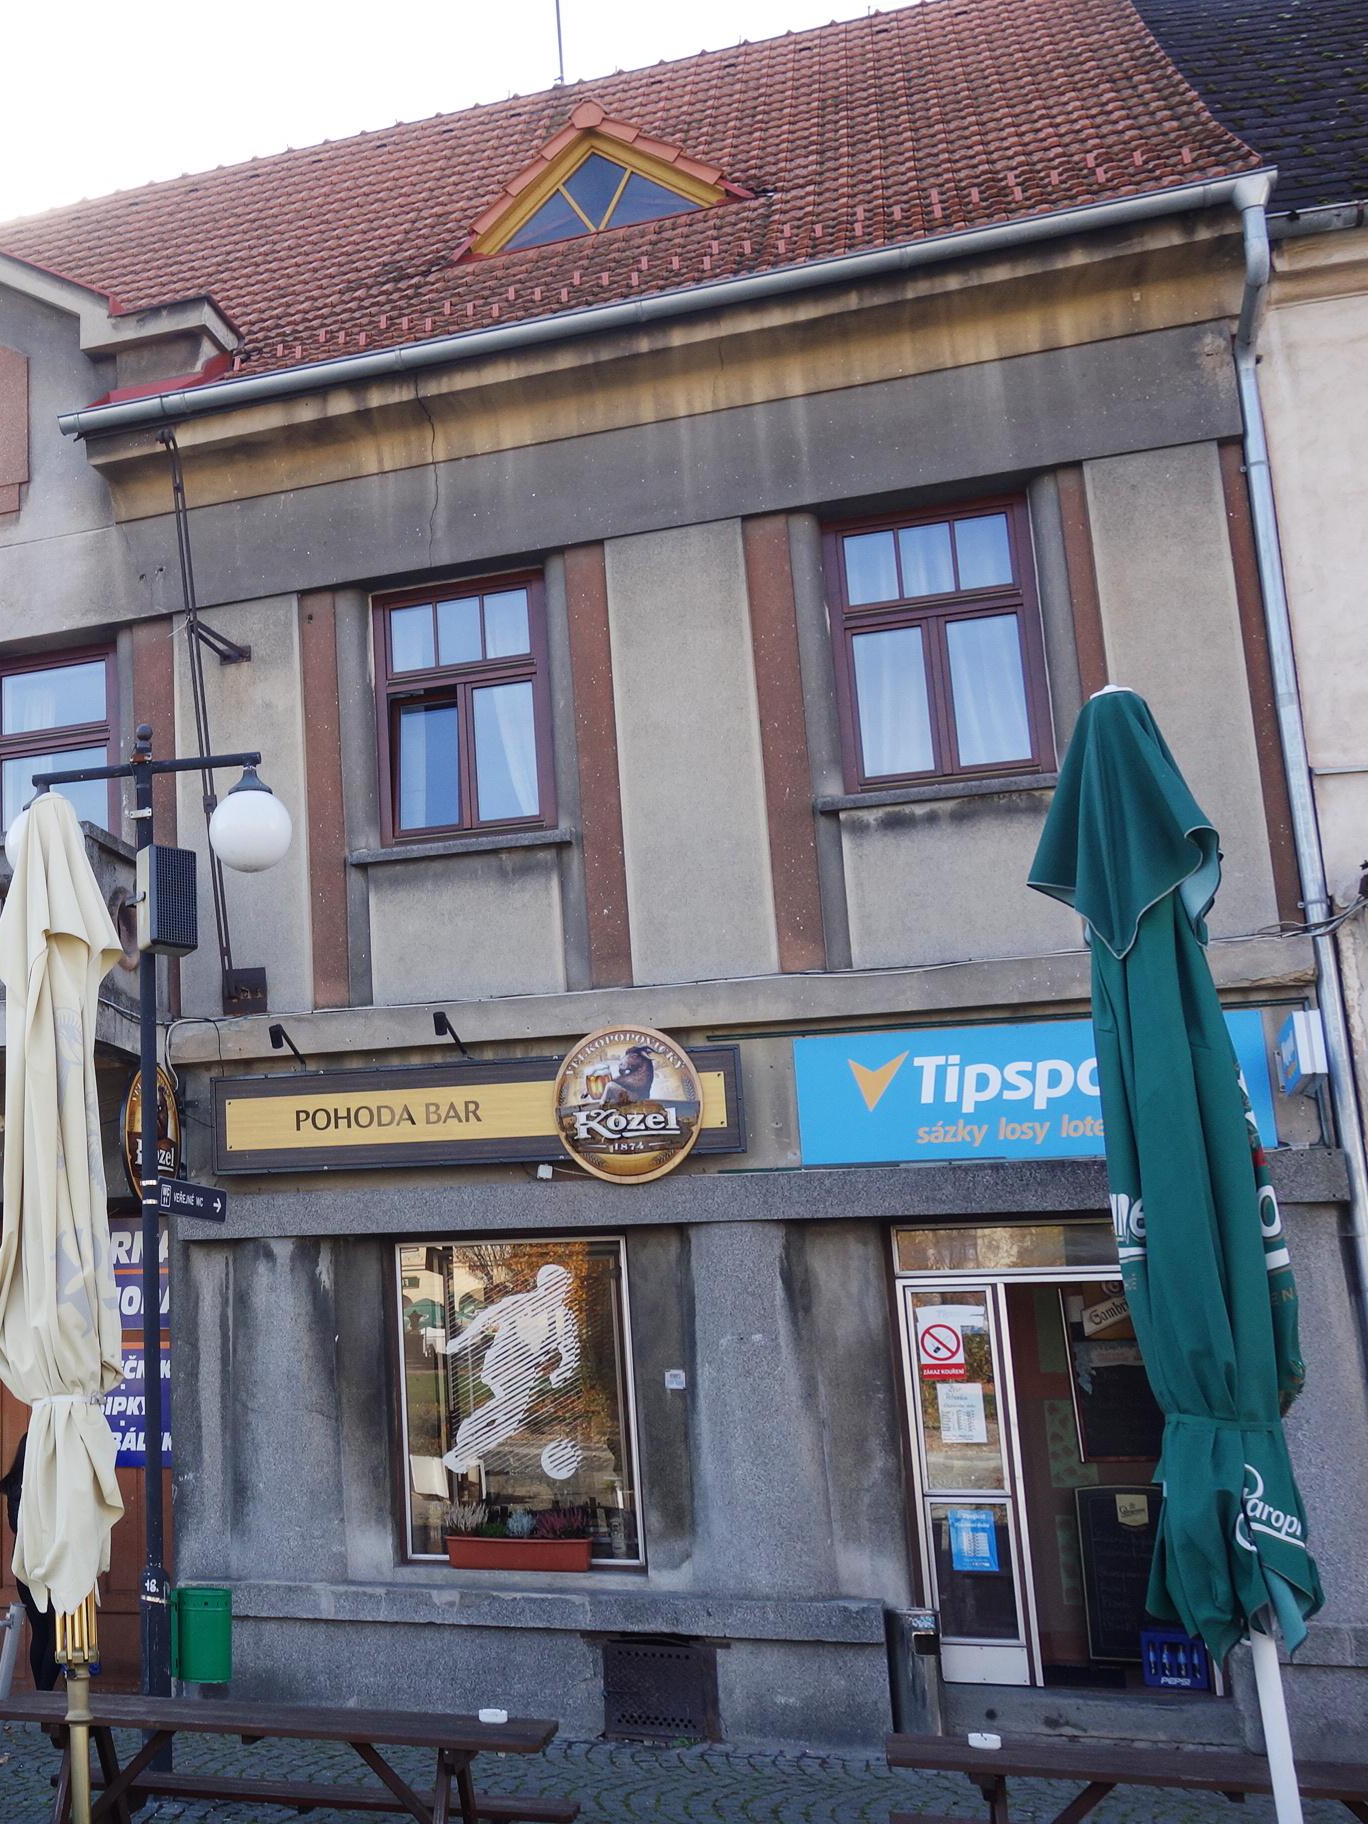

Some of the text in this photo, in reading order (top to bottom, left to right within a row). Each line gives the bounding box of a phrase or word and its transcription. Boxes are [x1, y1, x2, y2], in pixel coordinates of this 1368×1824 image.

[295, 1100, 483, 1131] POHODA BAR
[573, 1107, 680, 1140] Kozel
[916, 1119, 988, 1146] sázky
[998, 1116, 1050, 1144] losy
